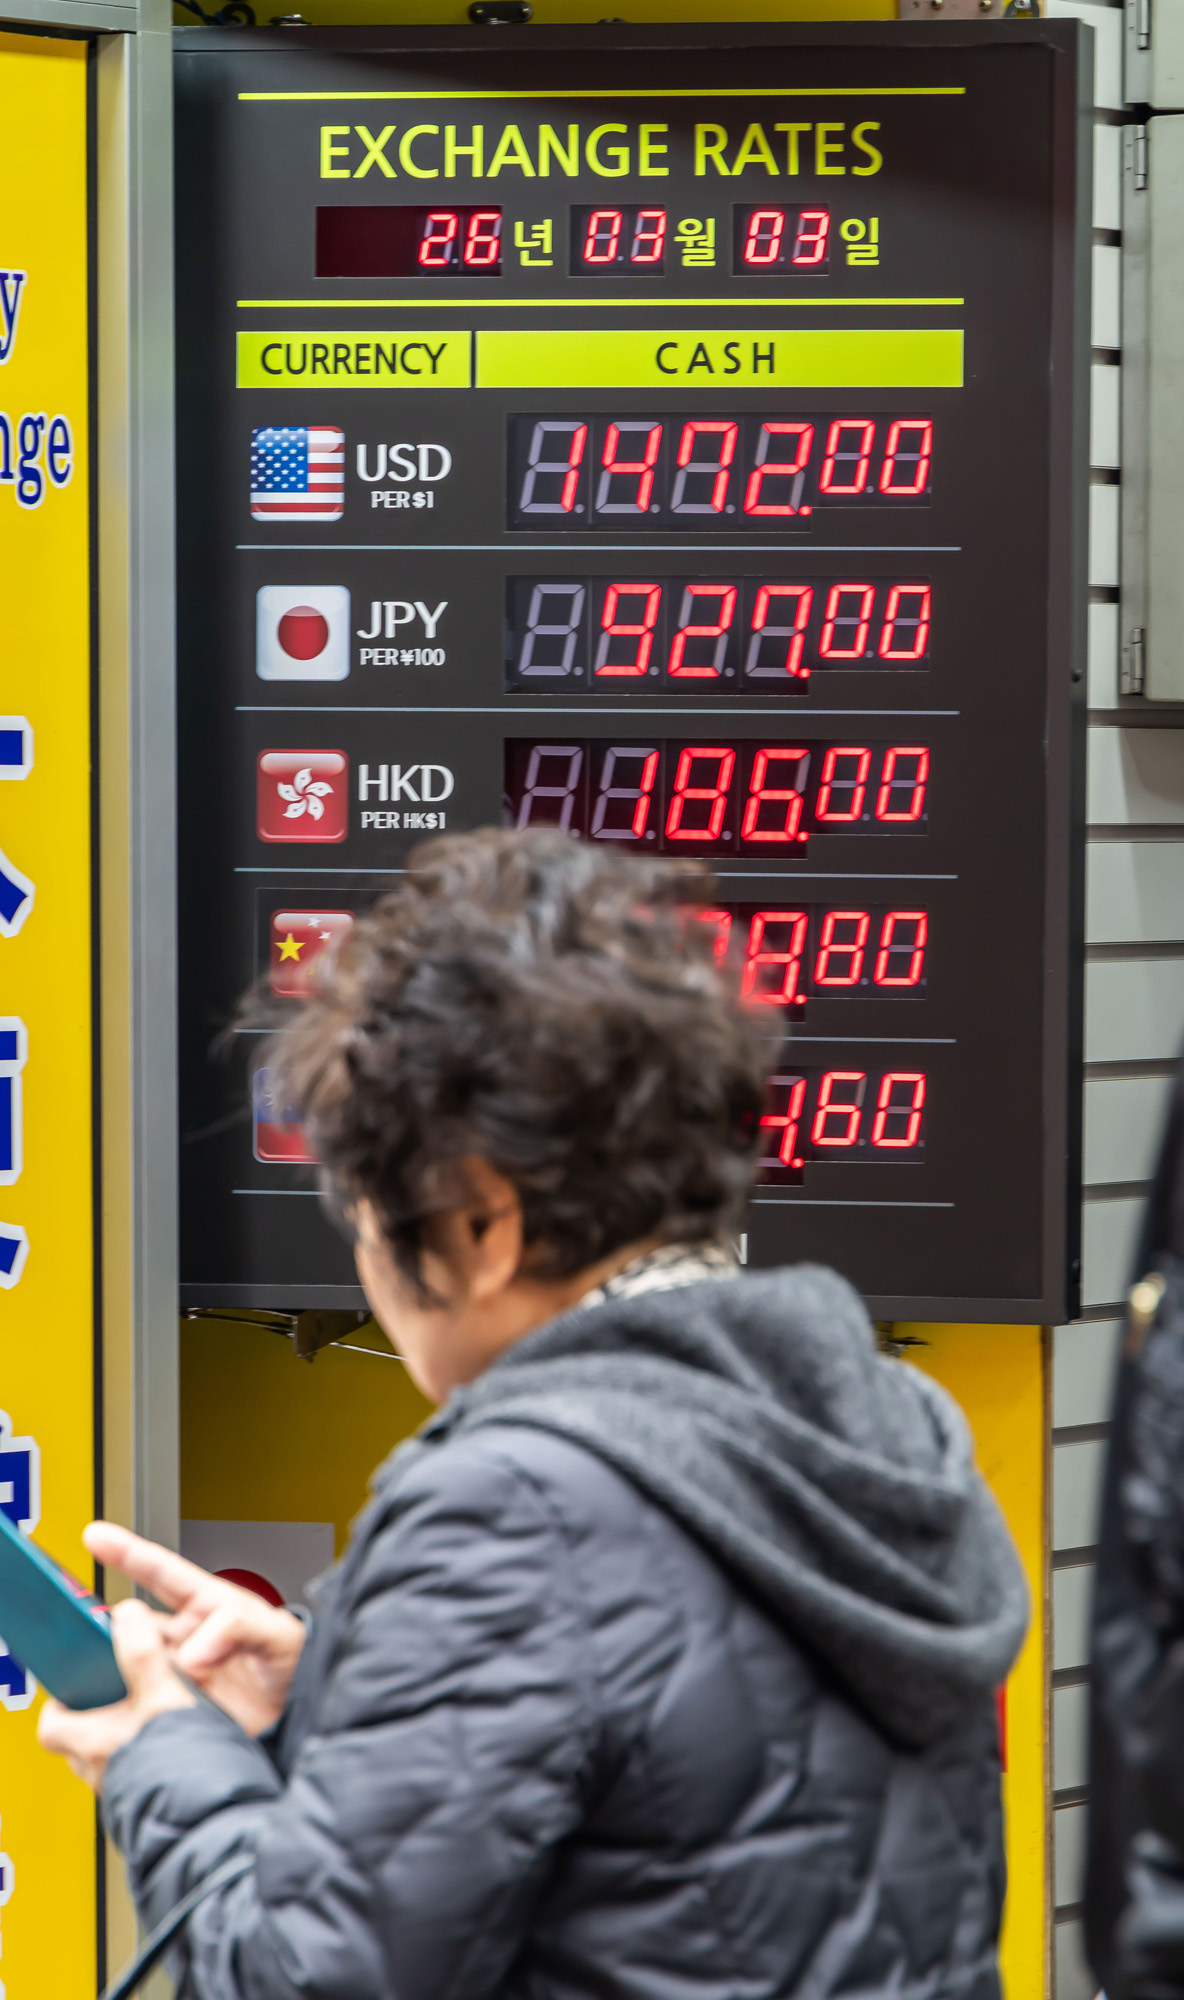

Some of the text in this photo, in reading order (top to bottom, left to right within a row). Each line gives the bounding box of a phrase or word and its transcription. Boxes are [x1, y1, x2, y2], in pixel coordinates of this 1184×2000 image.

[319, 121, 883, 179] EXCHANGE RATES
[417, 209, 880, 267] 26 년 03 월 03 일
[261, 342, 447, 376] CURRENCY
[656, 341, 776, 375] CASH
[356, 443, 453, 482] USD
[356, 600, 449, 640] JPY
[358, 764, 455, 802] HKD
[360, 811, 446, 830] PER HK$1
